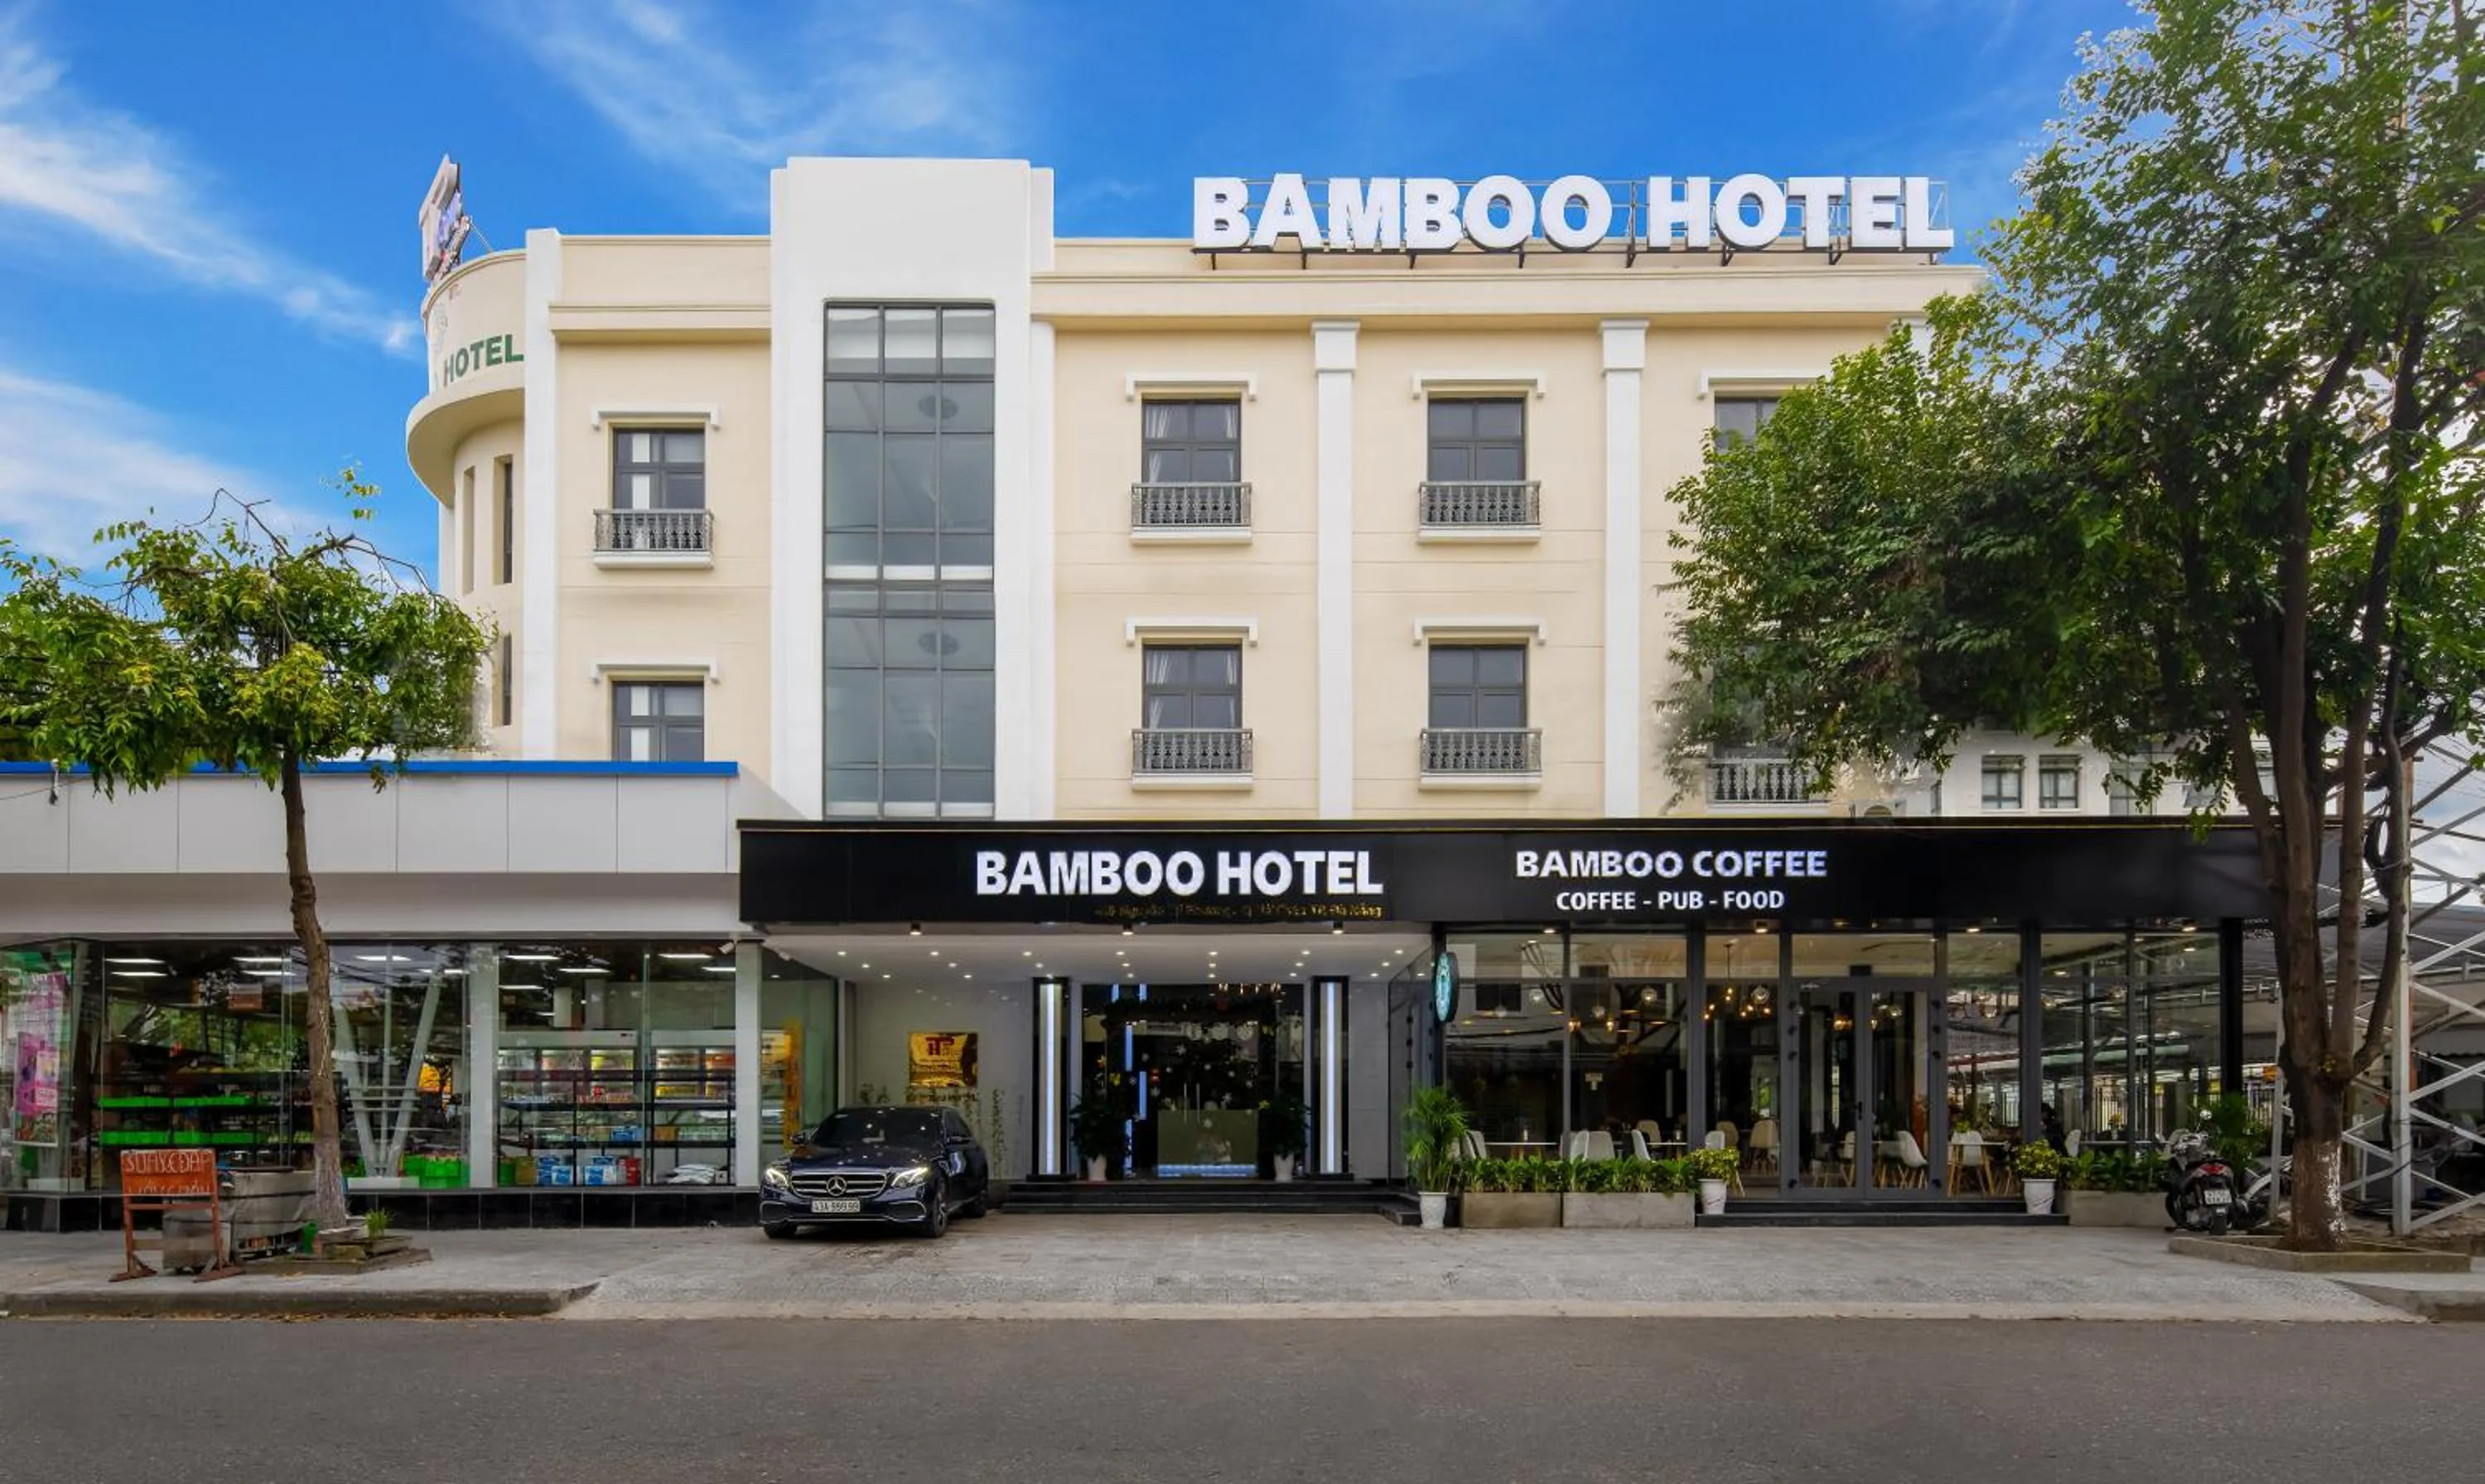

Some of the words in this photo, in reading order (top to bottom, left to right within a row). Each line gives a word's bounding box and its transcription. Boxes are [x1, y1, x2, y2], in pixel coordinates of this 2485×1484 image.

[1192, 172, 1614, 253] BAMBOO
[1648, 172, 1955, 252] HOTEL
[442, 334, 524, 388] HOTEL
[977, 850, 1205, 896] BAMBOO
[1217, 850, 1384, 896] HOTEL
[1516, 850, 1684, 878] BAMBOO
[1691, 850, 1828, 878] COFFEE
[1556, 891, 1636, 911] COFFEE
[1658, 891, 1704, 910] PUB
[1723, 890, 1785, 909] FOOD
